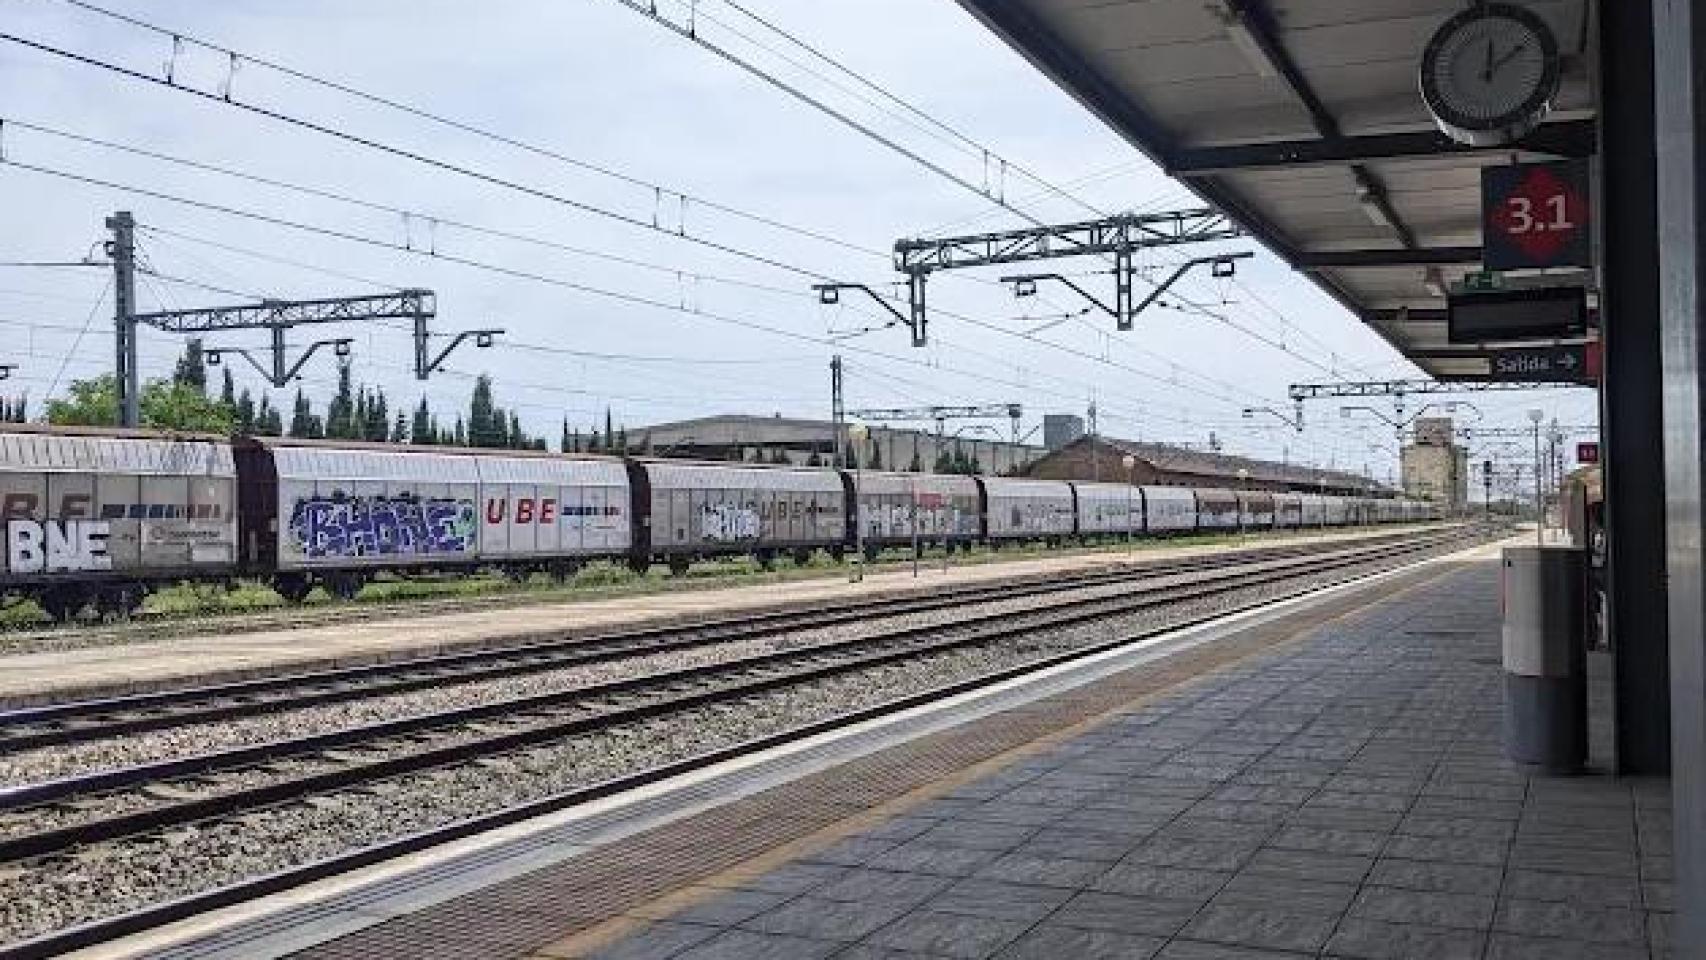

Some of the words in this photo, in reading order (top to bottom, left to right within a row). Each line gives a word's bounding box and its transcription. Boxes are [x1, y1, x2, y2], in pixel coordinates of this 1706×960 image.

[1507, 194, 1574, 233] 3.1
[486, 498, 556, 524] UBE
[9, 520, 112, 573] BNE
